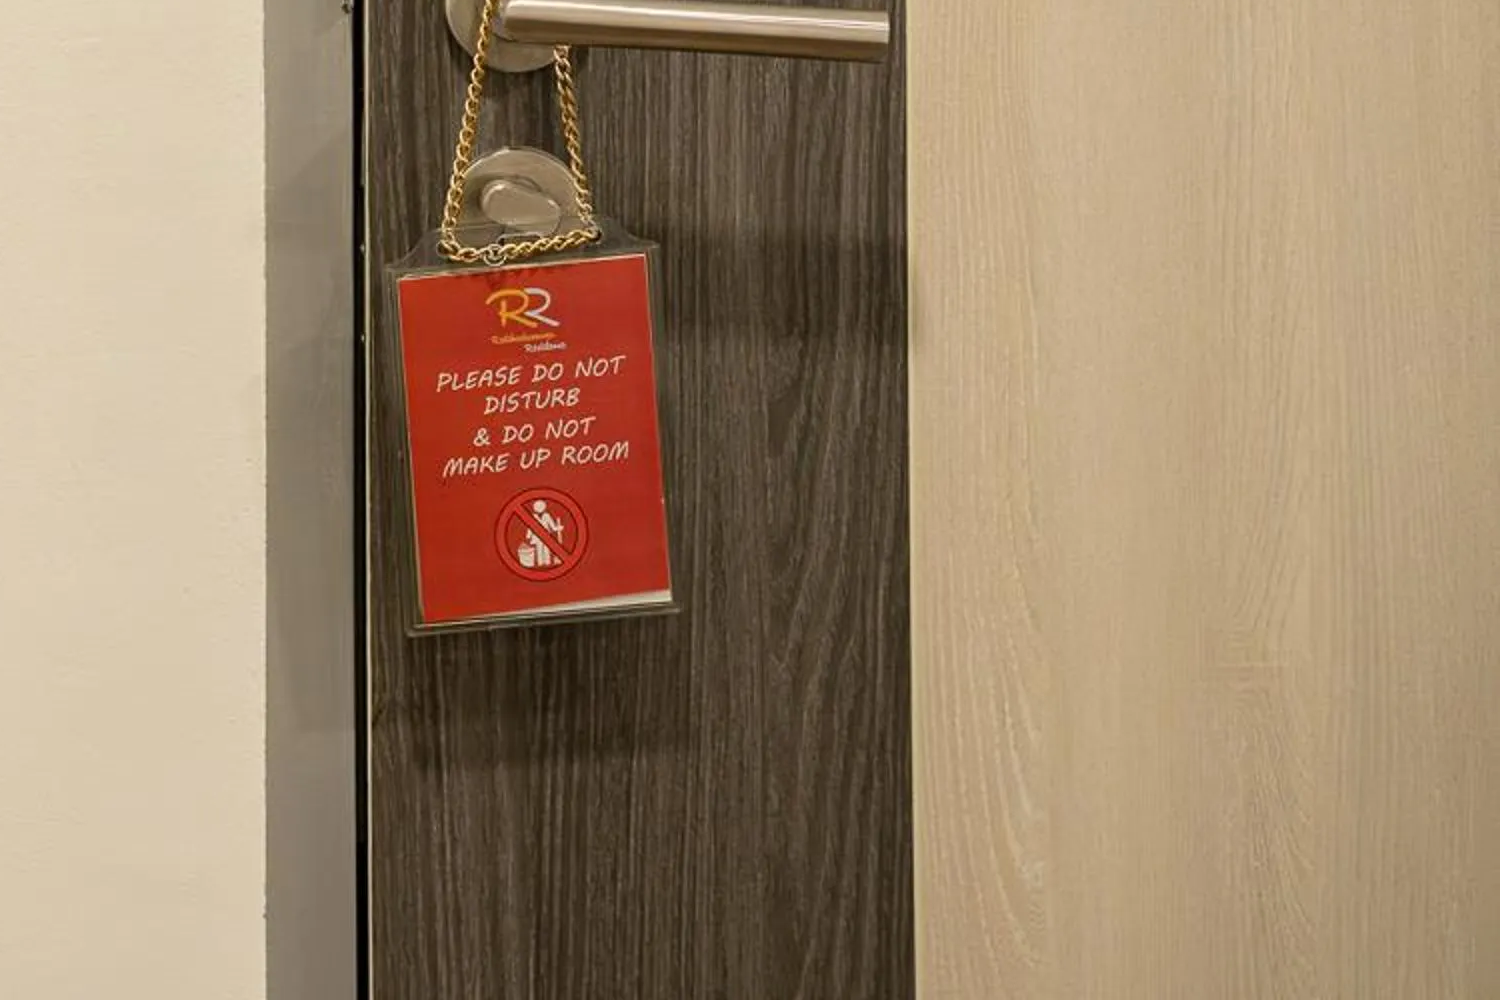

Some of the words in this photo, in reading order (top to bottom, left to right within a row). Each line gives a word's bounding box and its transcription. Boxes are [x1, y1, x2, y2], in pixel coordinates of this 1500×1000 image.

[437, 365, 521, 392] PLEASE
[531, 361, 564, 382] DO
[574, 355, 626, 379] NOT
[484, 387, 581, 415] DISTURB
[473, 427, 491, 447] &
[502, 423, 534, 443] DO
[545, 416, 597, 440] NOT
[443, 453, 510, 479] MAKE
[519, 448, 551, 470] UP
[561, 440, 630, 466] ROOM
